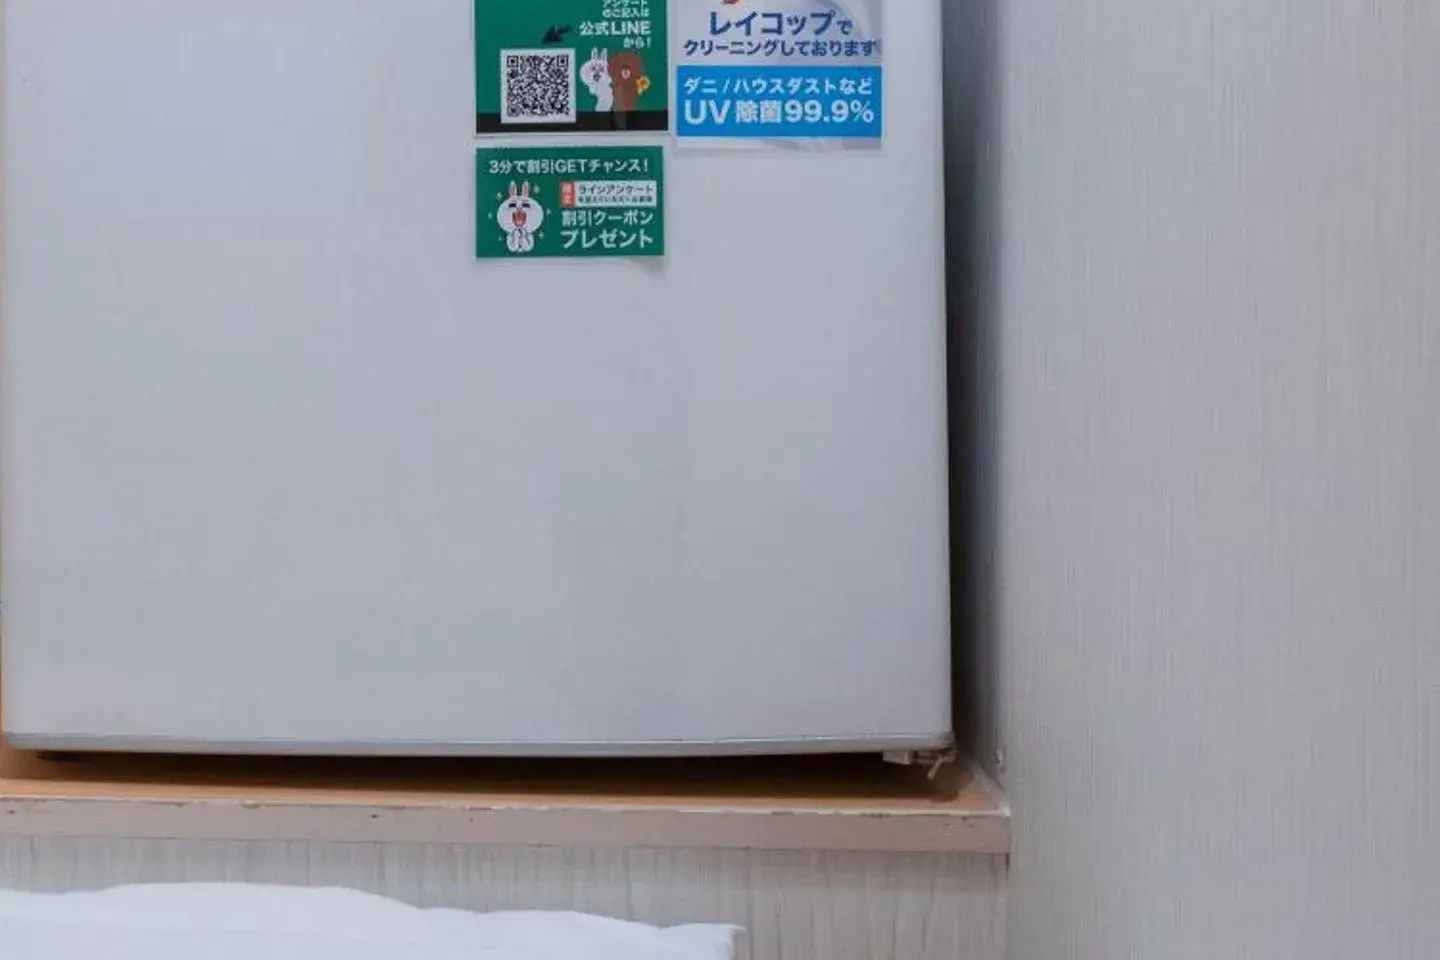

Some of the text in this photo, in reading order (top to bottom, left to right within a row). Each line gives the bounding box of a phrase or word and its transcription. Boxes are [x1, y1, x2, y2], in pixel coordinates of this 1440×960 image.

[579, 20, 652, 36] 公式LINE
[709, 10, 853, 36] レイコップで
[683, 40, 877, 57] クリーニングしております
[561, 210, 654, 227] 割引クーポン
[561, 228, 654, 249] プレゼント
